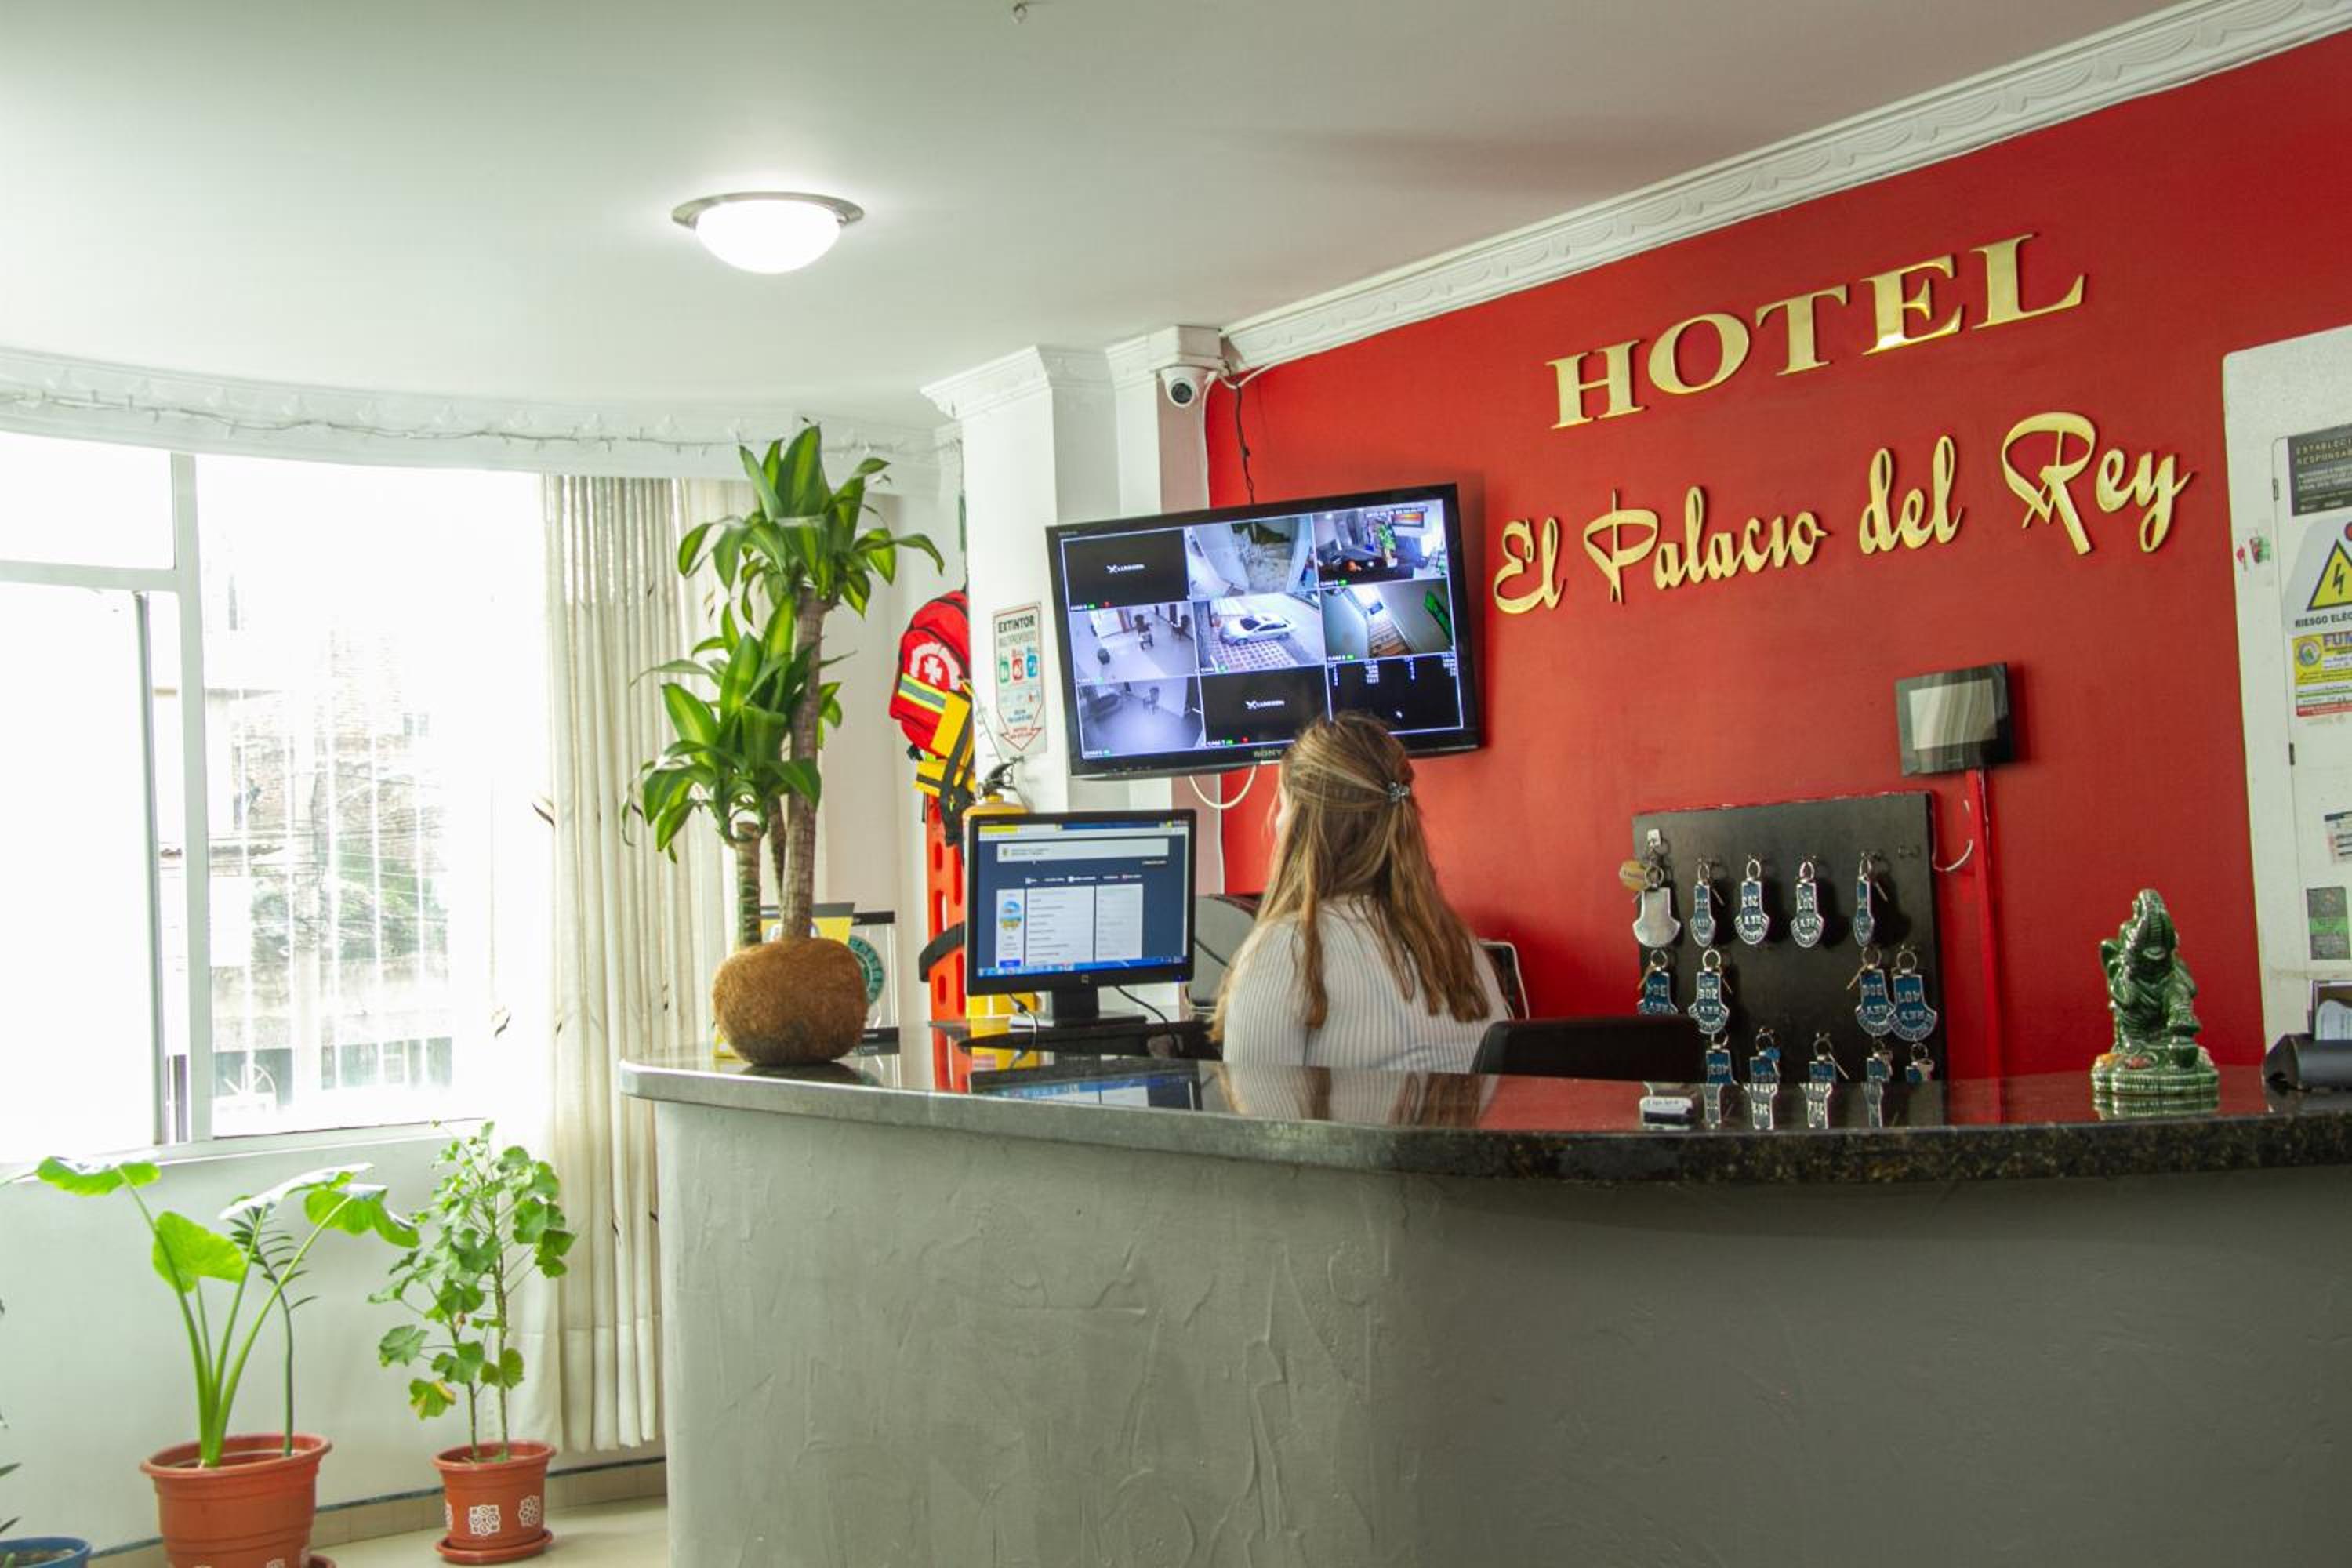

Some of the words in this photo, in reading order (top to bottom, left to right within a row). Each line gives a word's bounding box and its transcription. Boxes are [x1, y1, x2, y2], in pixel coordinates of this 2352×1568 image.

[1546, 233, 2085, 430] HOTEL
[1494, 517, 1566, 615] El
[1583, 486, 1830, 604] Palacio
[1859, 435, 1962, 554] del
[2001, 412, 2192, 555] Rey
[998, 615, 1035, 633] EXTINTOR
[2295, 615, 2328, 628] RIESGO
[1254, 749, 1283, 758] SONY
